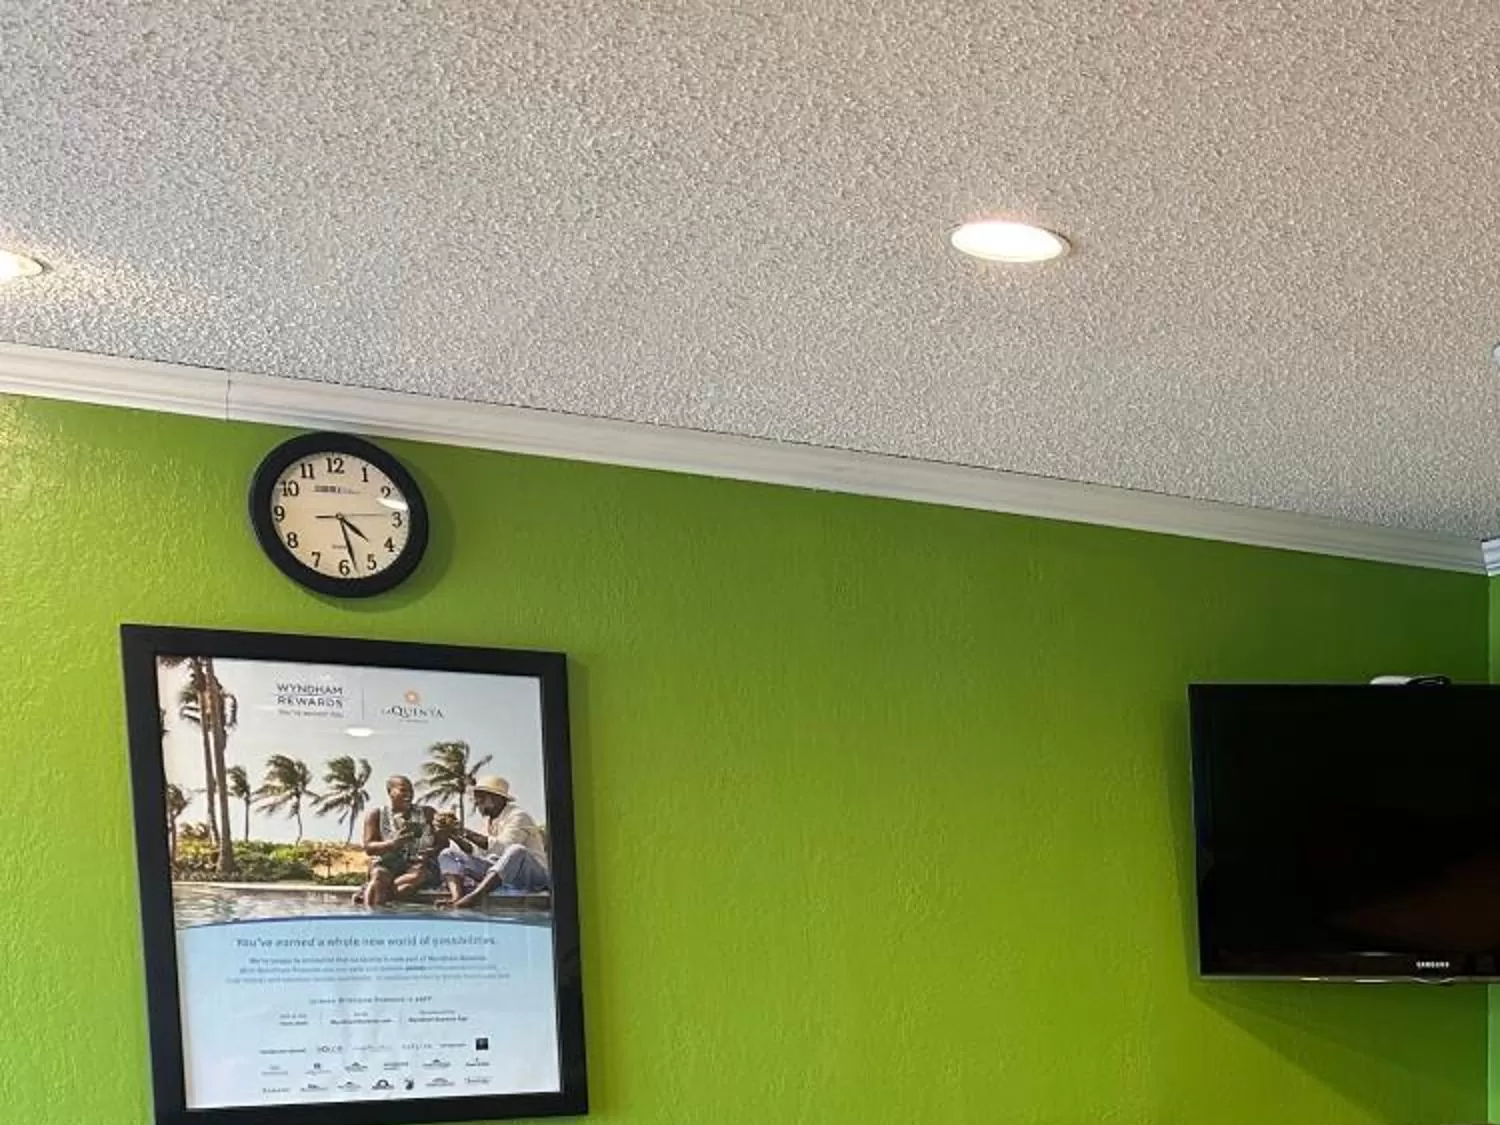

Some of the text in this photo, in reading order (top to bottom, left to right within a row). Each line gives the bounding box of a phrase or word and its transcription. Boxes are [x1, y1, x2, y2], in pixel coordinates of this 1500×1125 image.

[300, 463, 315, 480] 11
[326, 457, 345, 474] 12
[361, 467, 369, 483] 1
[281, 480, 299, 497] 10
[381, 486, 391, 499] 2
[273, 505, 286, 522] 9
[391, 511, 403, 529] 3
[286, 532, 299, 549] 8
[383, 537, 395, 553] 4
[311, 551, 321, 567] 7
[366, 553, 378, 571] 5
[338, 560, 351, 576] 6
[276, 683, 343, 695] WYNDHAM
[277, 695, 343, 708] REWARDS
[1416, 961, 1450, 969] SAMSUNG
